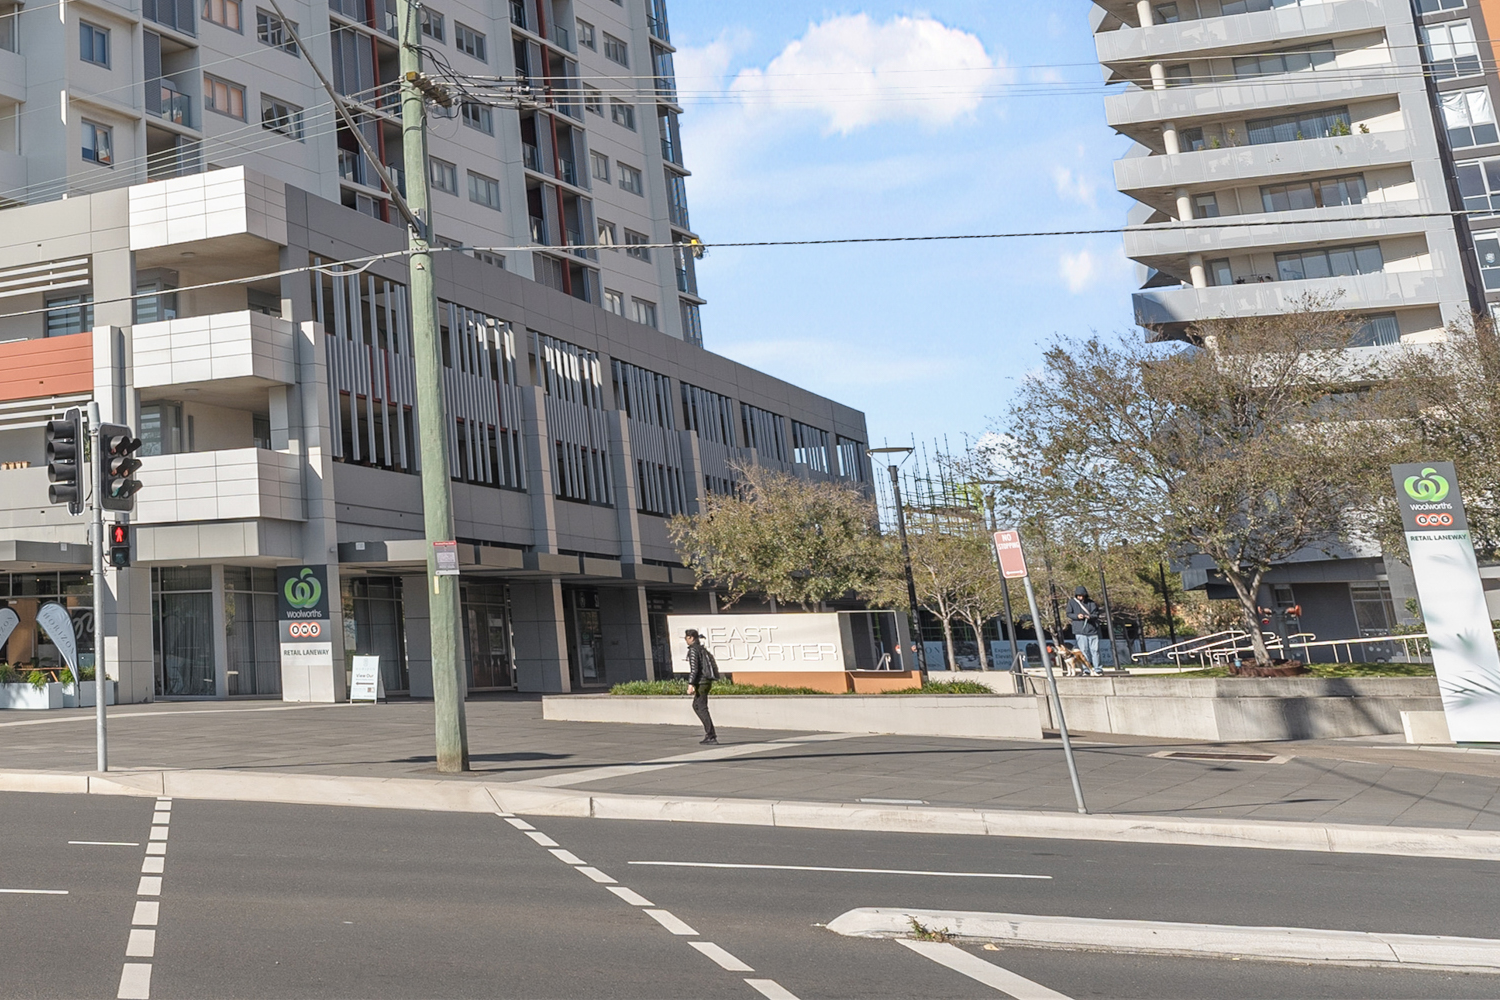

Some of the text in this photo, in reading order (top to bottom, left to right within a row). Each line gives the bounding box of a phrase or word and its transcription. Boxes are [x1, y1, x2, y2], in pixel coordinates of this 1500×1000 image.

[1409, 502, 1453, 511] woolworths
[1001, 533, 1012, 542] NO
[997, 542, 1020, 550] STOPPING
[286, 609, 322, 618] woolworths
[42, 612, 75, 655] HORIZON
[710, 625, 778, 644] EAST
[302, 648, 330, 656] LANEWAY
[712, 642, 839, 662] QUARTER
